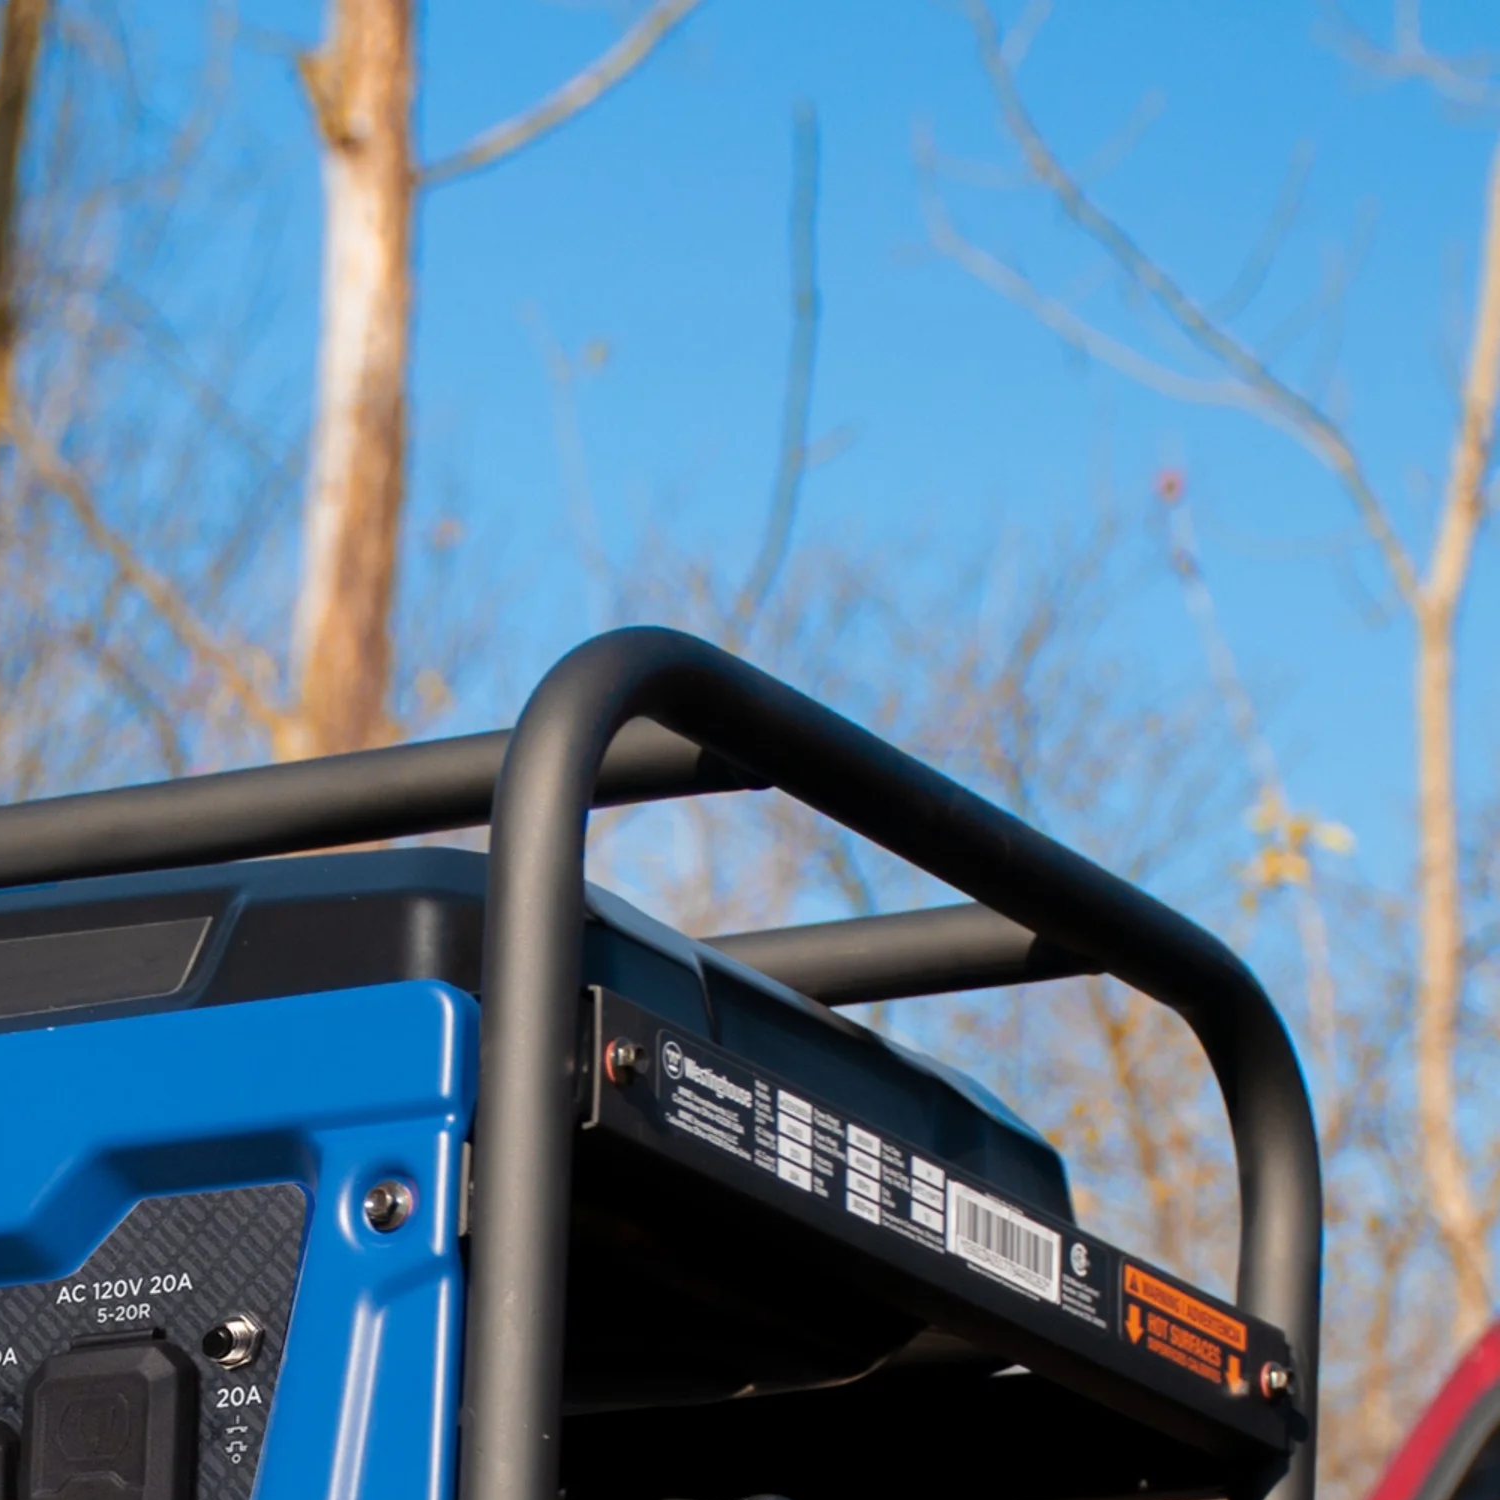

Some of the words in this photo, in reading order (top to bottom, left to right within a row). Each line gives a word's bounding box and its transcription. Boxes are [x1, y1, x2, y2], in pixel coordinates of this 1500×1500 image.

[56, 1285, 87, 1304] AC
[93, 1278, 143, 1300] 120V
[149, 1272, 193, 1294] 20A
[97, 1303, 151, 1323] 5-20R
[1147, 1312, 1168, 1340] HOT
[1169, 1324, 1222, 1367] SURFACES
[216, 1385, 262, 1408] 20A
